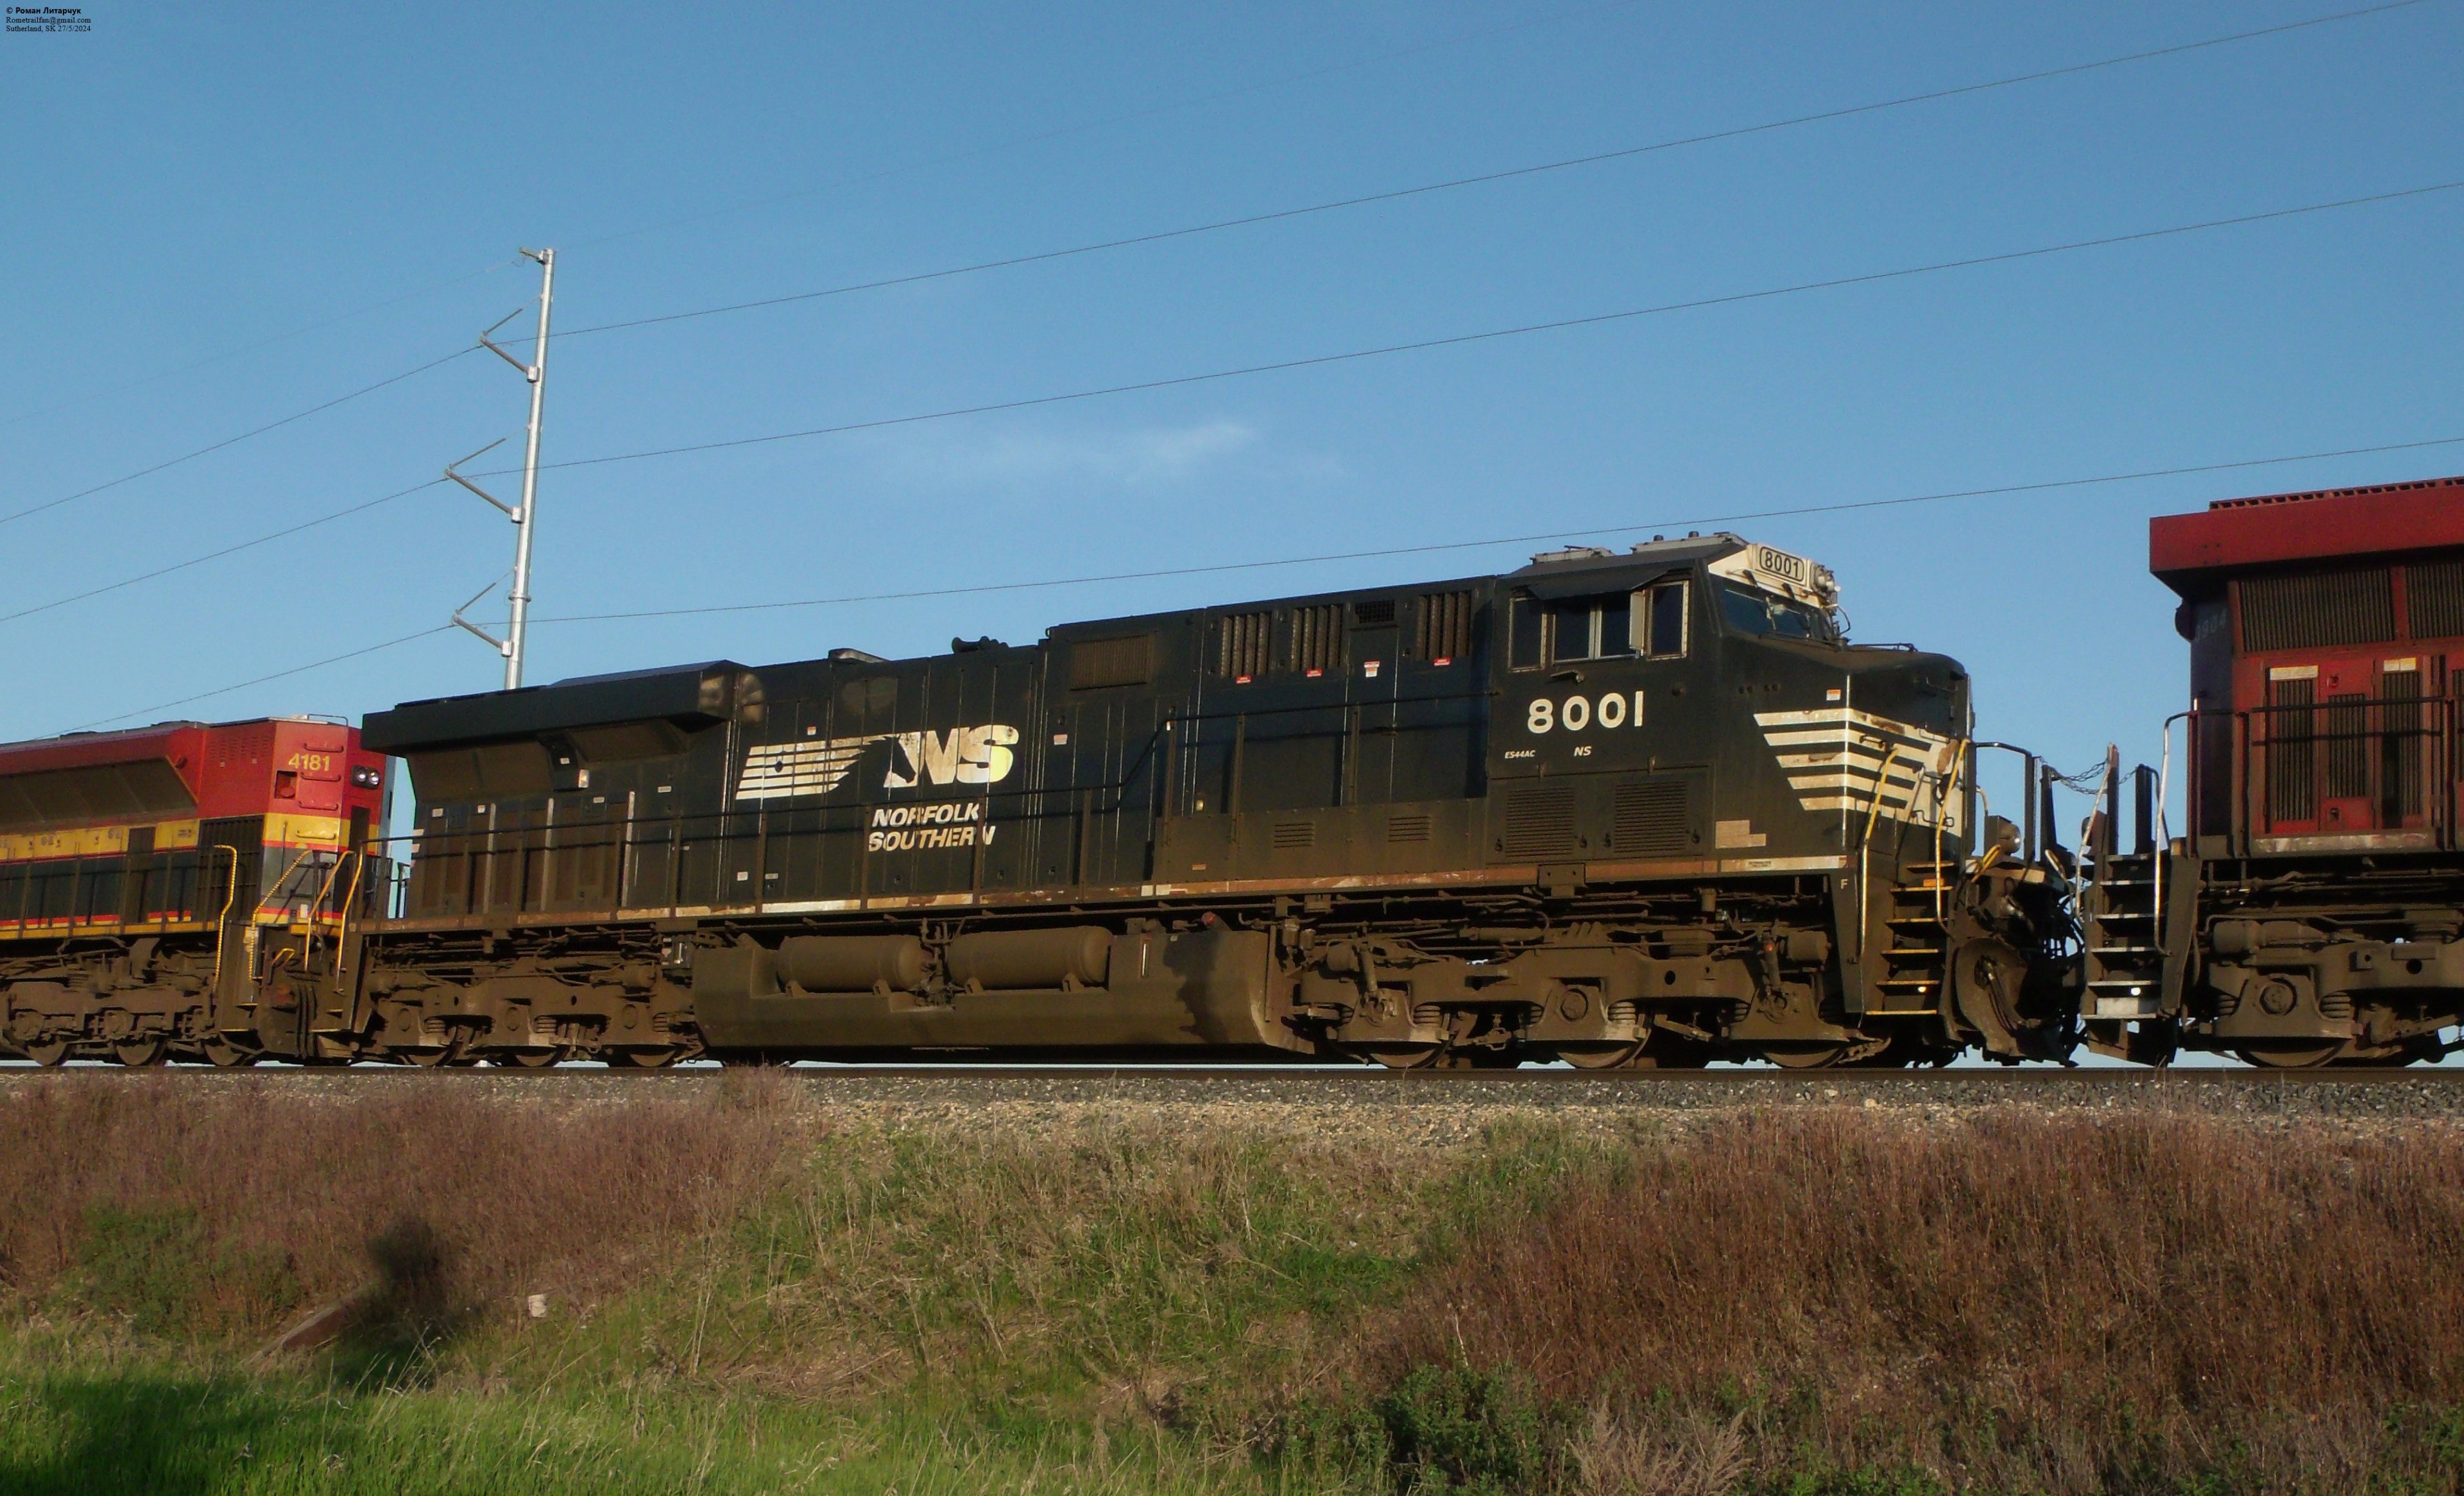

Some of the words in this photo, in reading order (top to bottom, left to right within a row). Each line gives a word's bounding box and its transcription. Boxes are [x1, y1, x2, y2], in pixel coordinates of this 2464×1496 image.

[1765, 551, 1799, 577] 8001
[1527, 690, 1644, 733] 8001
[1505, 749, 1536, 759] ES44AC
[1573, 745, 1592, 757] NS
[288, 752, 330, 772] 4181
[871, 803, 979, 828] NORFOLK
[1841, 878, 1849, 889] F
